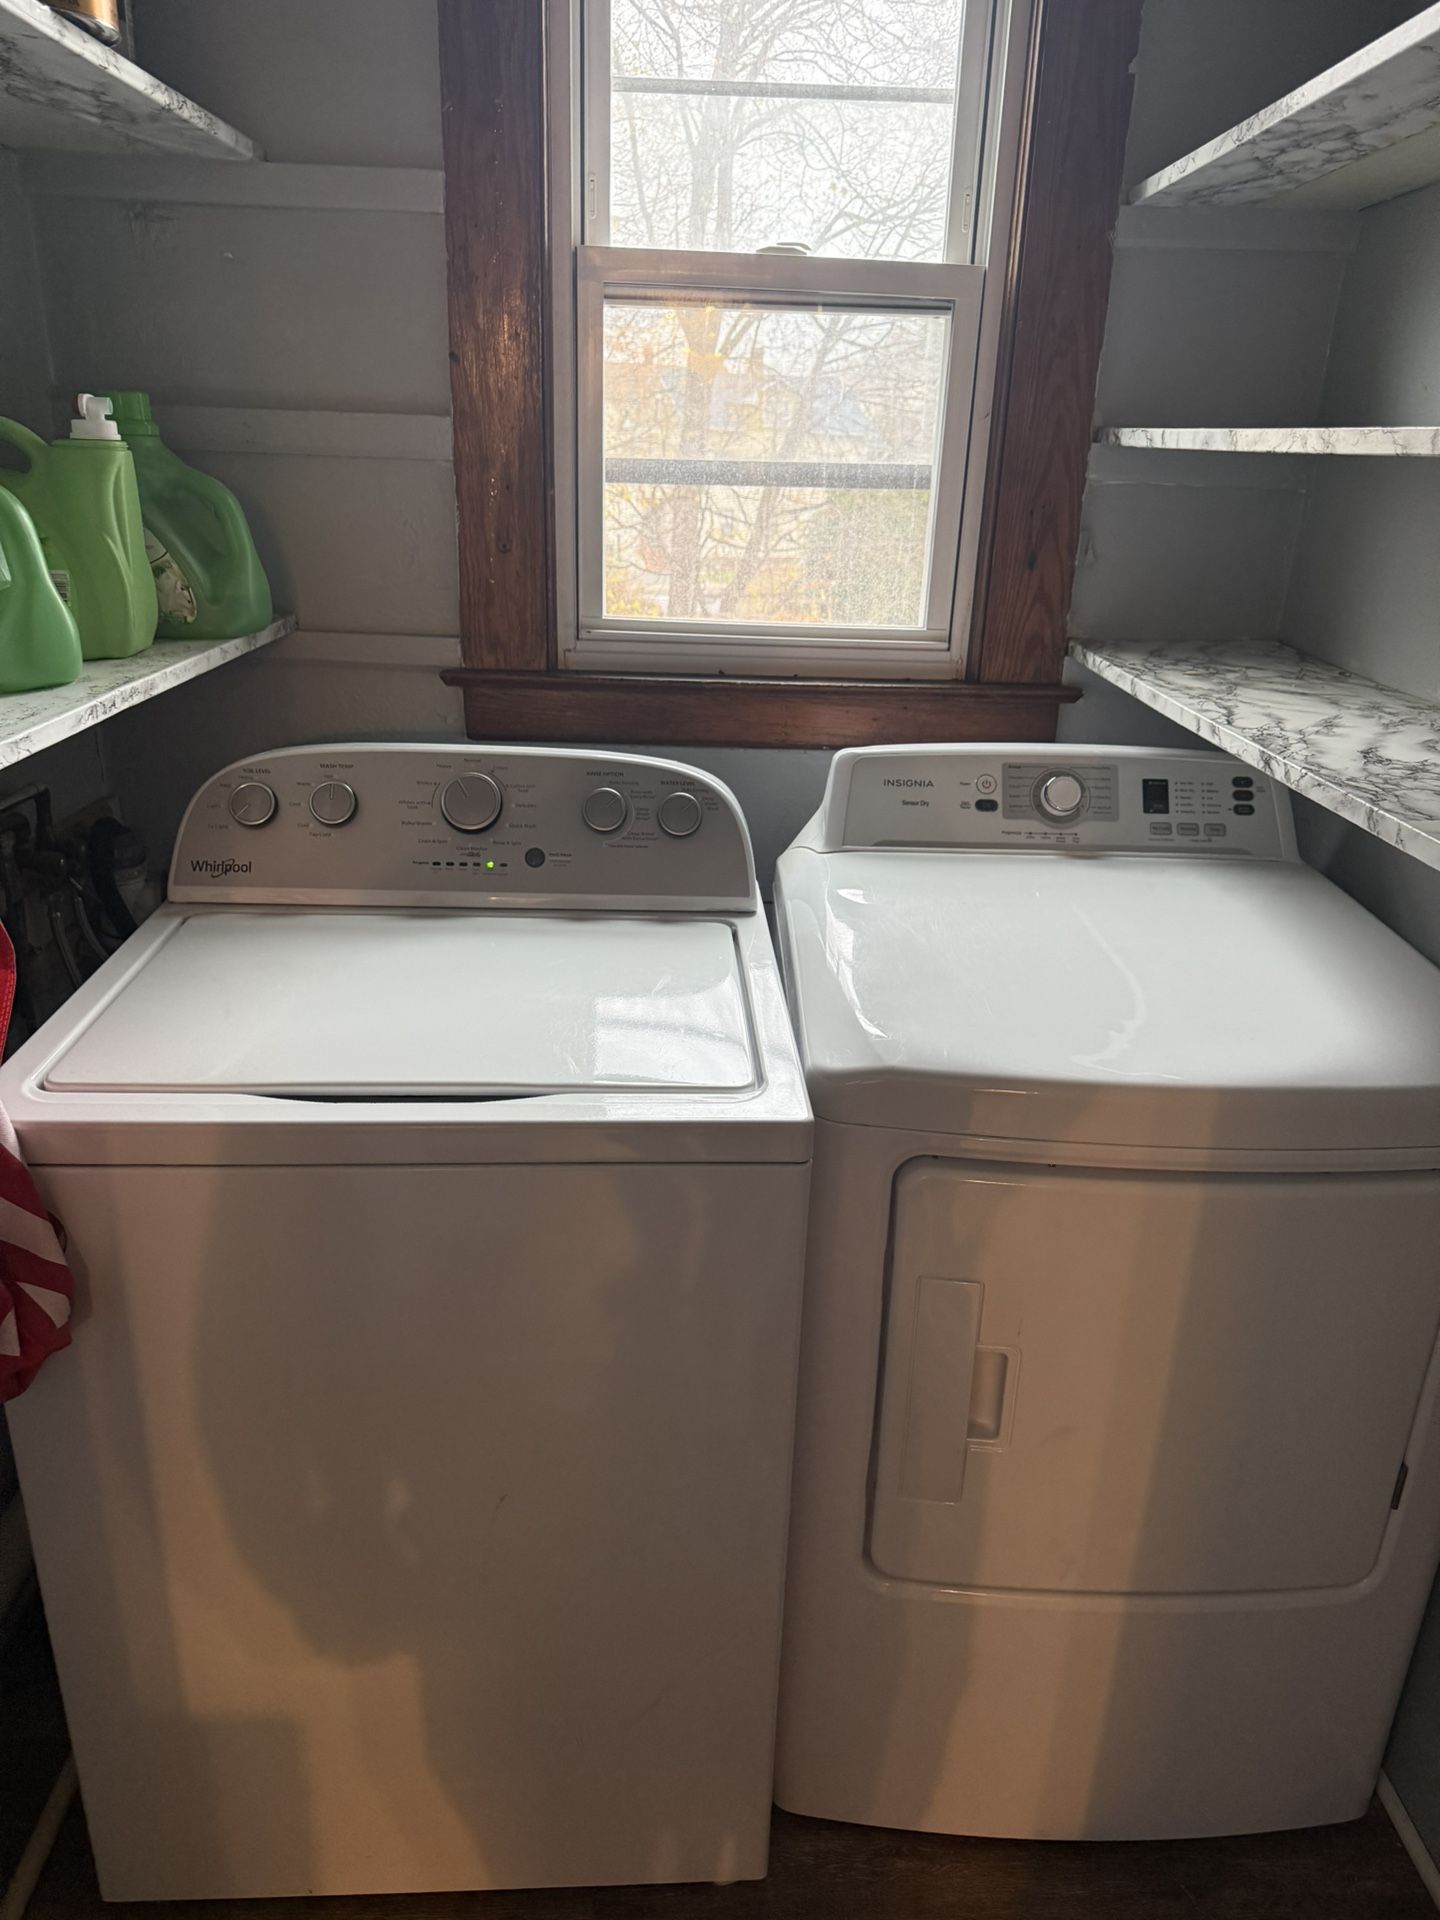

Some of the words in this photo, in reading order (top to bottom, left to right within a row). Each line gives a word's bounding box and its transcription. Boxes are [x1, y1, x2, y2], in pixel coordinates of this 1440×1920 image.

[883, 778, 934, 788] INSIGNIA
[919, 799, 930, 808] Dry
[190, 859, 252, 877] Whirlpool
